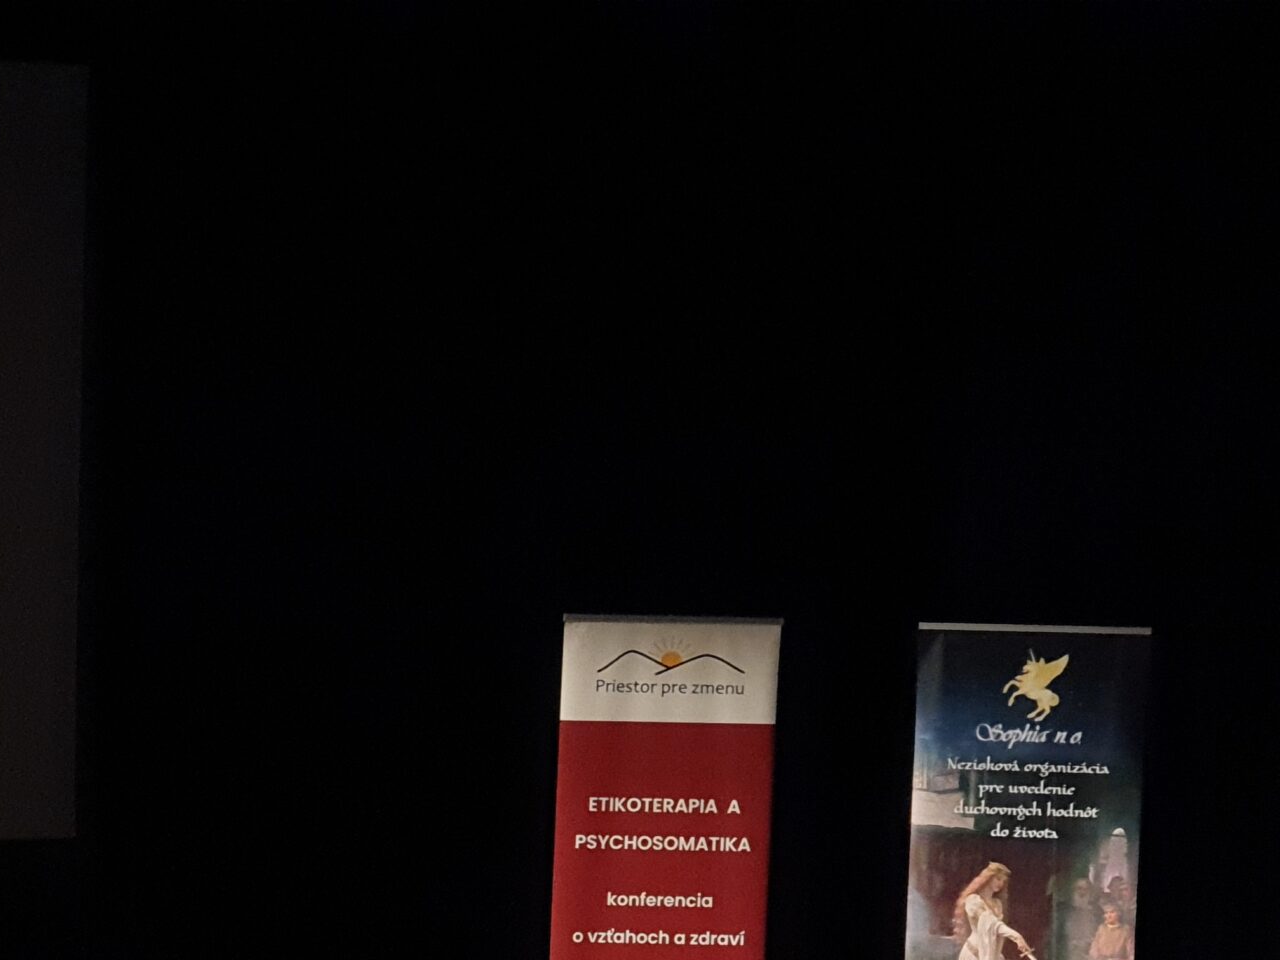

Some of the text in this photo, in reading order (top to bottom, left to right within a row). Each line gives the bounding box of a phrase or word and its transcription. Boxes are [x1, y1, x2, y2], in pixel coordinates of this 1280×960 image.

[595, 678, 745, 697] Priestor pre zmenu
[976, 723, 1051, 749] Sophia
[947, 756, 1110, 777] Nezisková organizácia
[978, 779, 1076, 798] pre uvedenie
[588, 796, 741, 815] ETIKOTERAPIA A
[953, 799, 1100, 821] duchovných hodnôt
[990, 823, 1059, 839] do života
[575, 834, 751, 853] PSYCHOSOMATIKA
[606, 891, 713, 909] konferencia
[572, 927, 745, 947] o vzťahoch a zdraví
